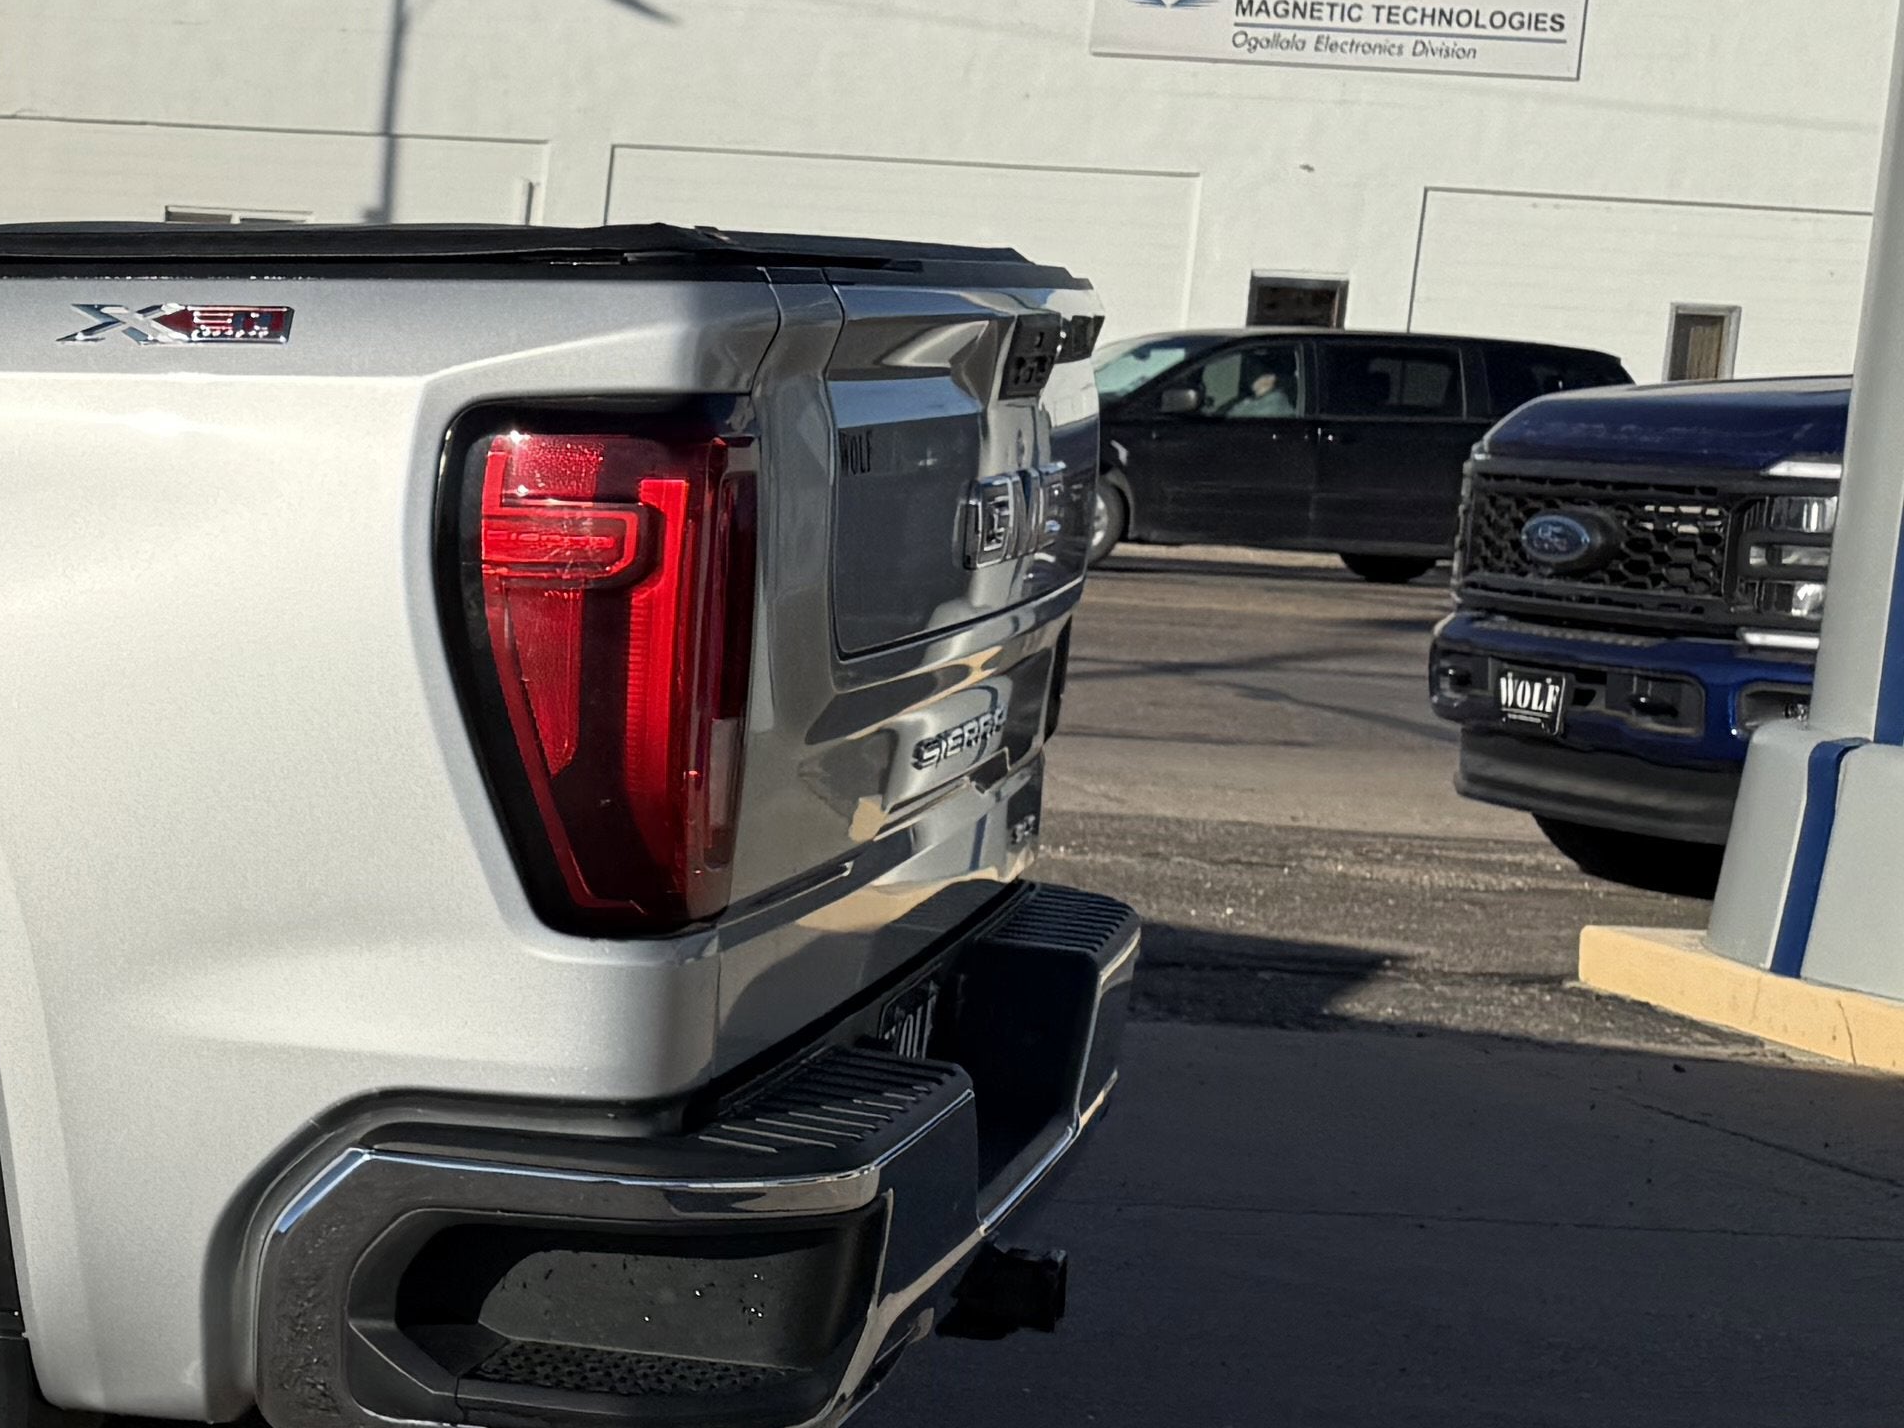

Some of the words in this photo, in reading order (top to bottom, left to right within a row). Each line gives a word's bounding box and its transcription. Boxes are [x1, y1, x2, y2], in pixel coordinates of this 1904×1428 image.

[1372, 3, 1566, 33] TECHNOLOGIES
[1231, 30, 1307, 54] Ogallala
[1313, 34, 1404, 58] Electronics
[1411, 39, 1478, 60] Division
[1500, 672, 1560, 713] WOLF
